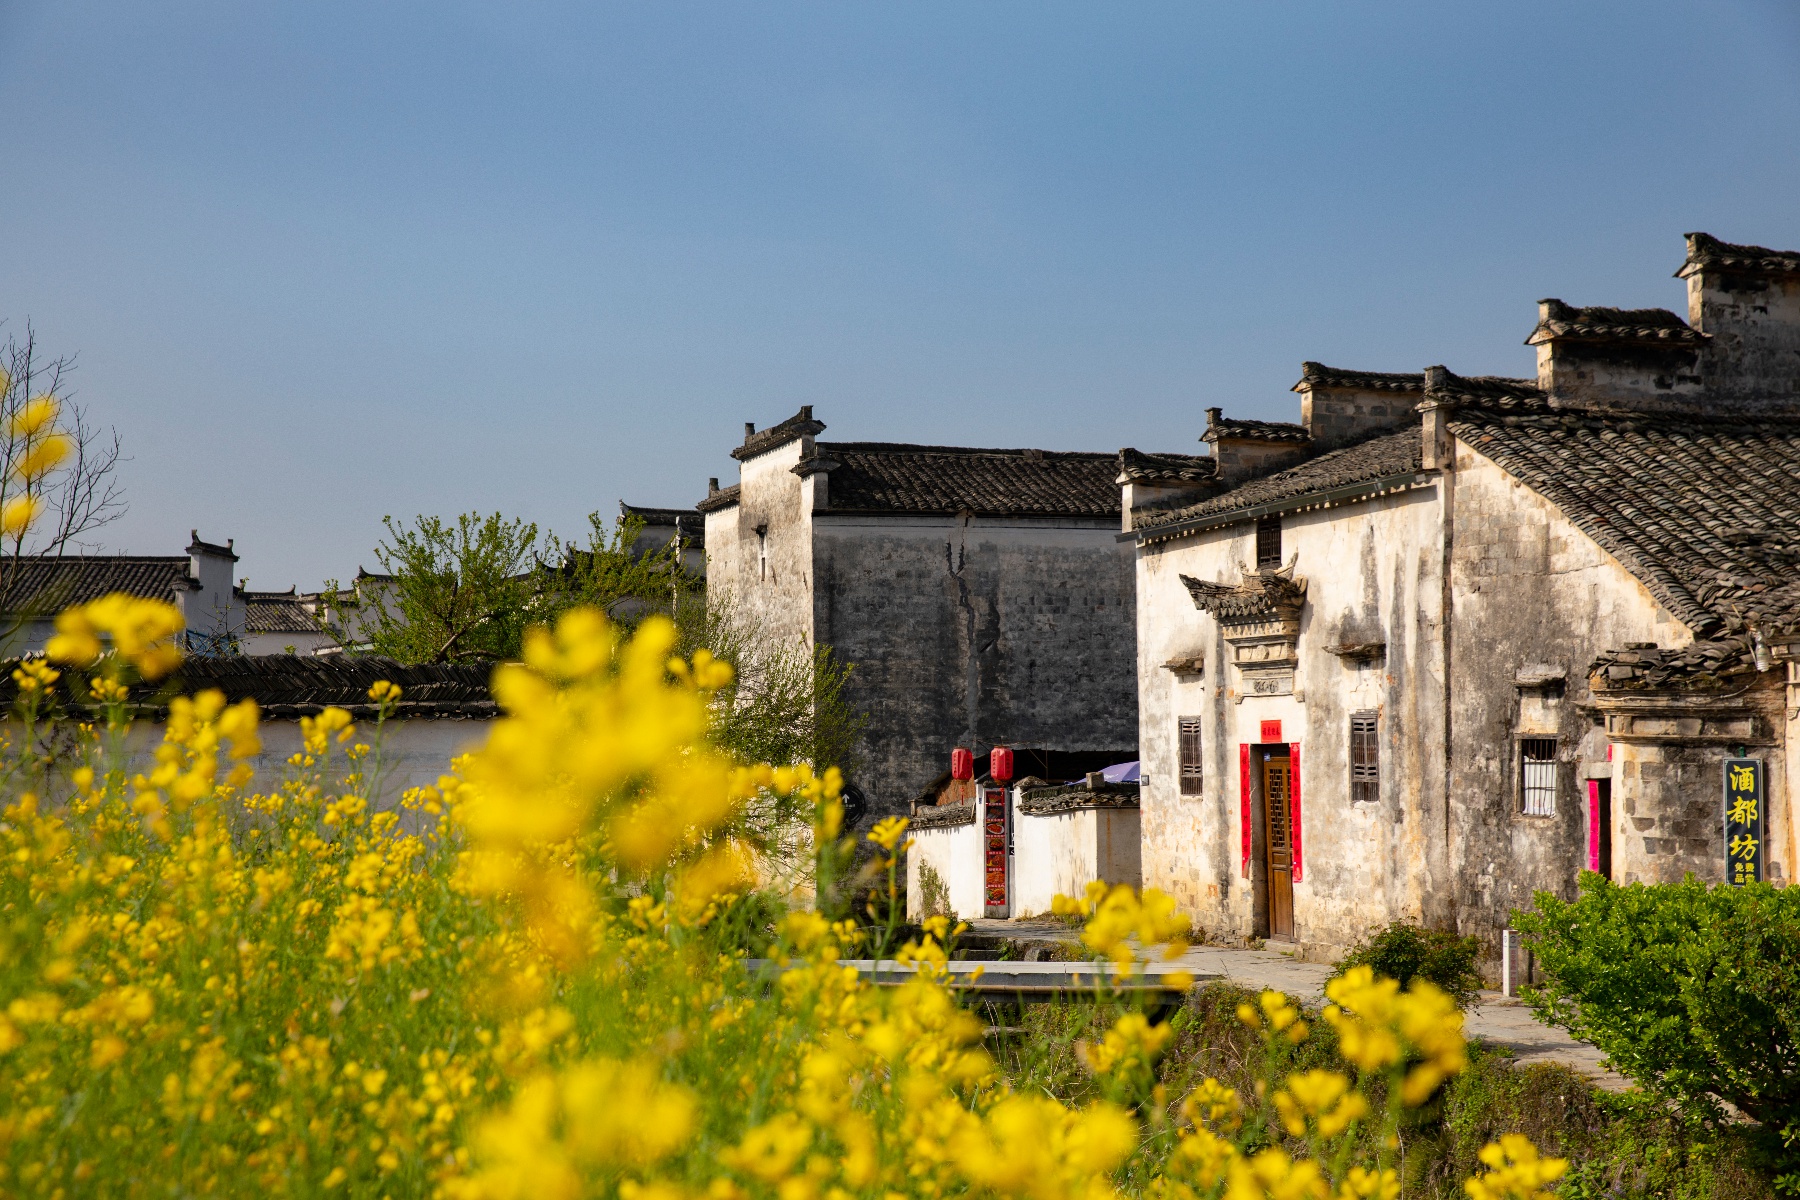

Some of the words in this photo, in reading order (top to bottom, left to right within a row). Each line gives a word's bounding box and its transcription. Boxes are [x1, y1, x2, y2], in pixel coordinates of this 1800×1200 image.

[1727, 764, 1759, 860] 酒都坊
[1735, 862, 1755, 872] 免费
